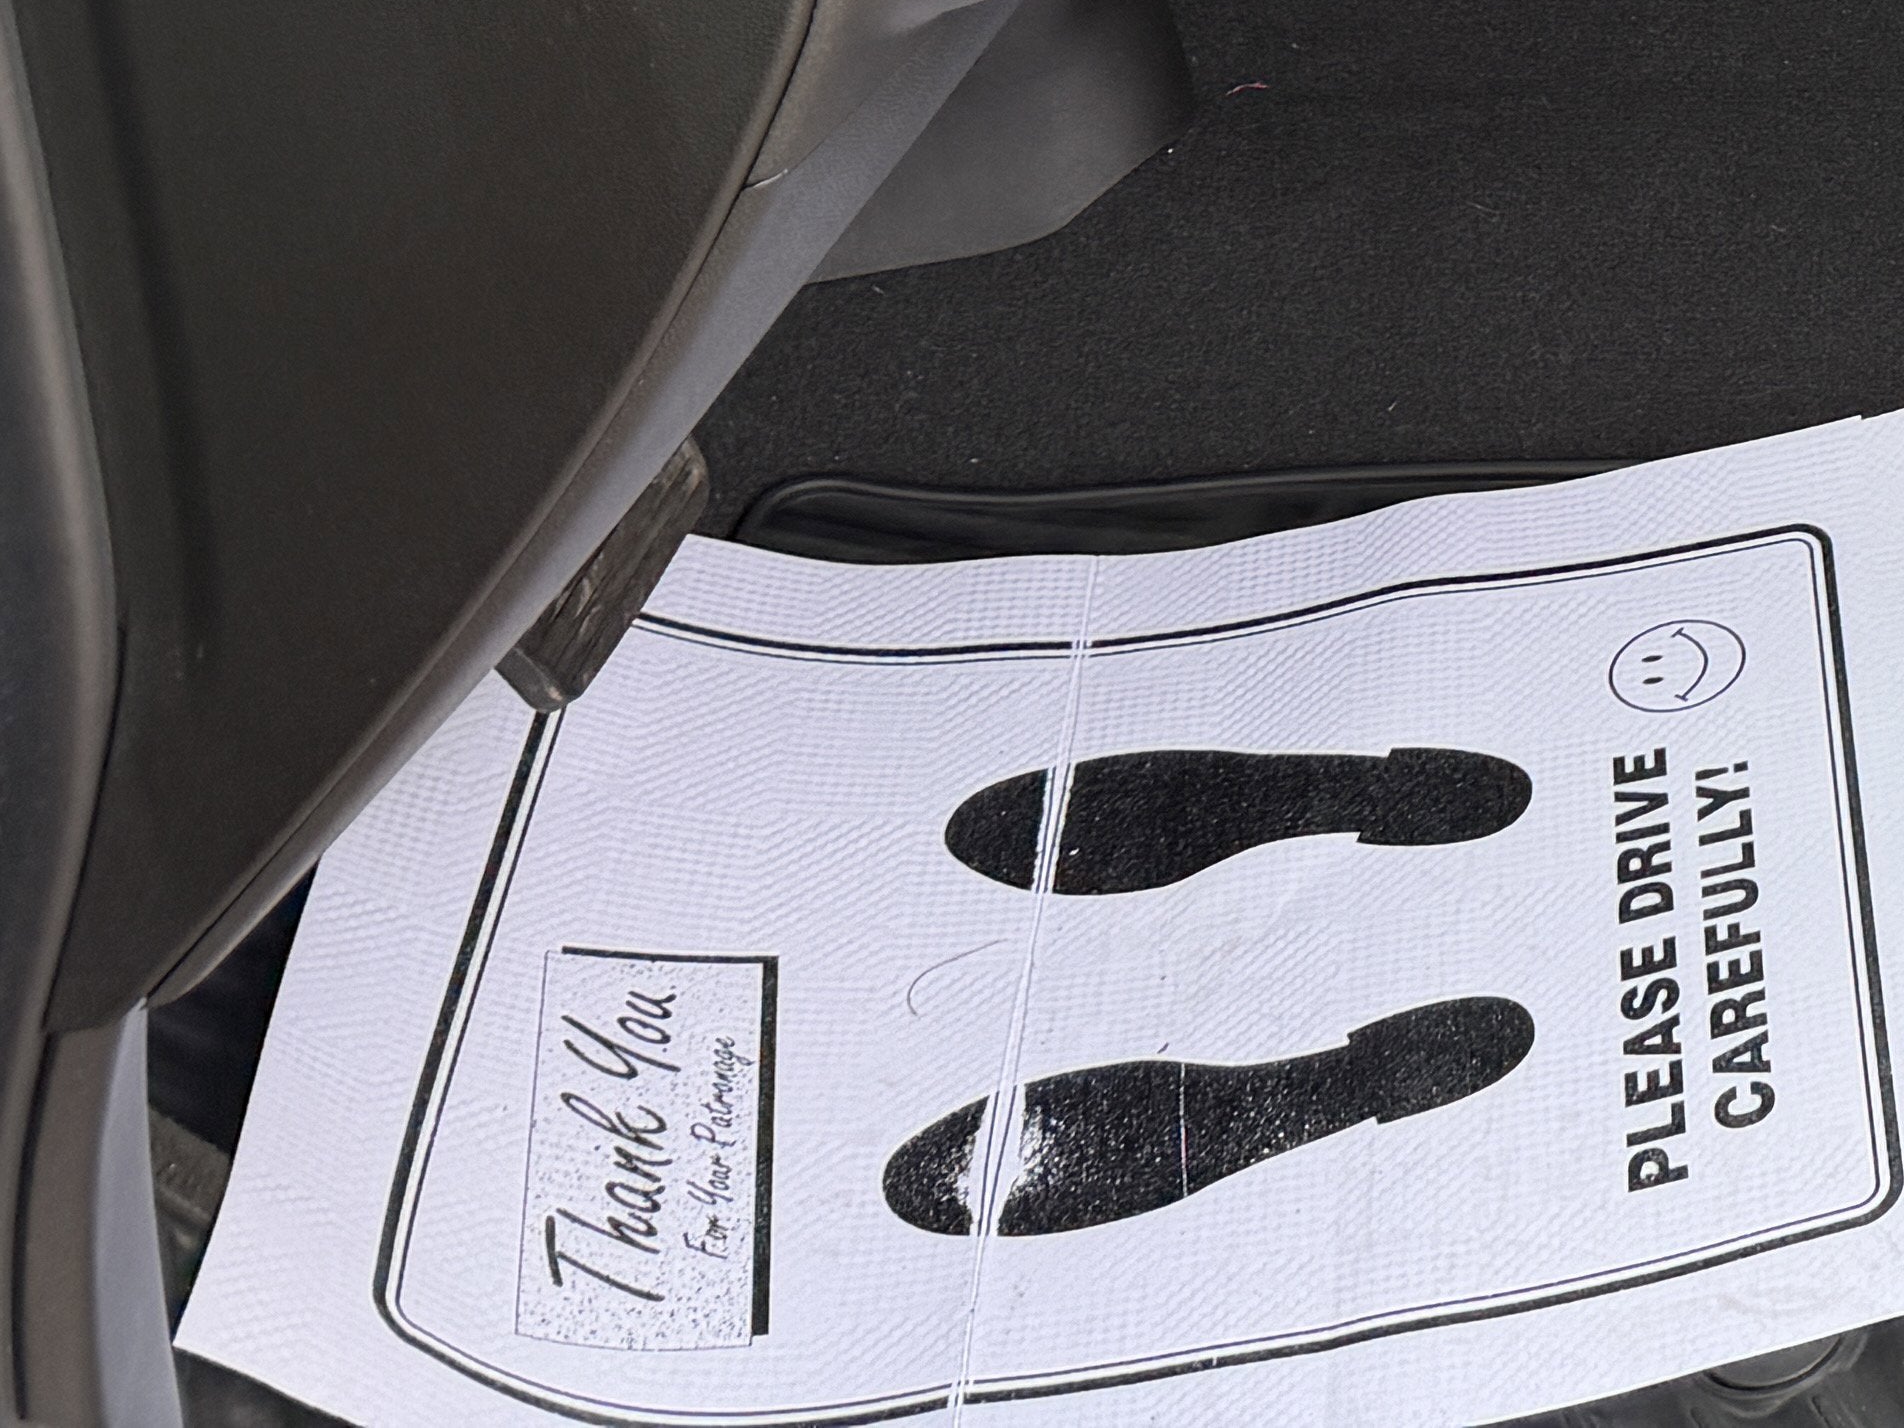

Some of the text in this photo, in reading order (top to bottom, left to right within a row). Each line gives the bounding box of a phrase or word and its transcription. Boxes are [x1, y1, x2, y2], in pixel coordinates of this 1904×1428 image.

[1612, 746, 1690, 1193] PLEASE DRIVE
[1694, 759, 1776, 1129] CAREFULLY!
[544, 988, 682, 1303] Thank You
[682, 1036, 755, 1260] For Your Patronage
